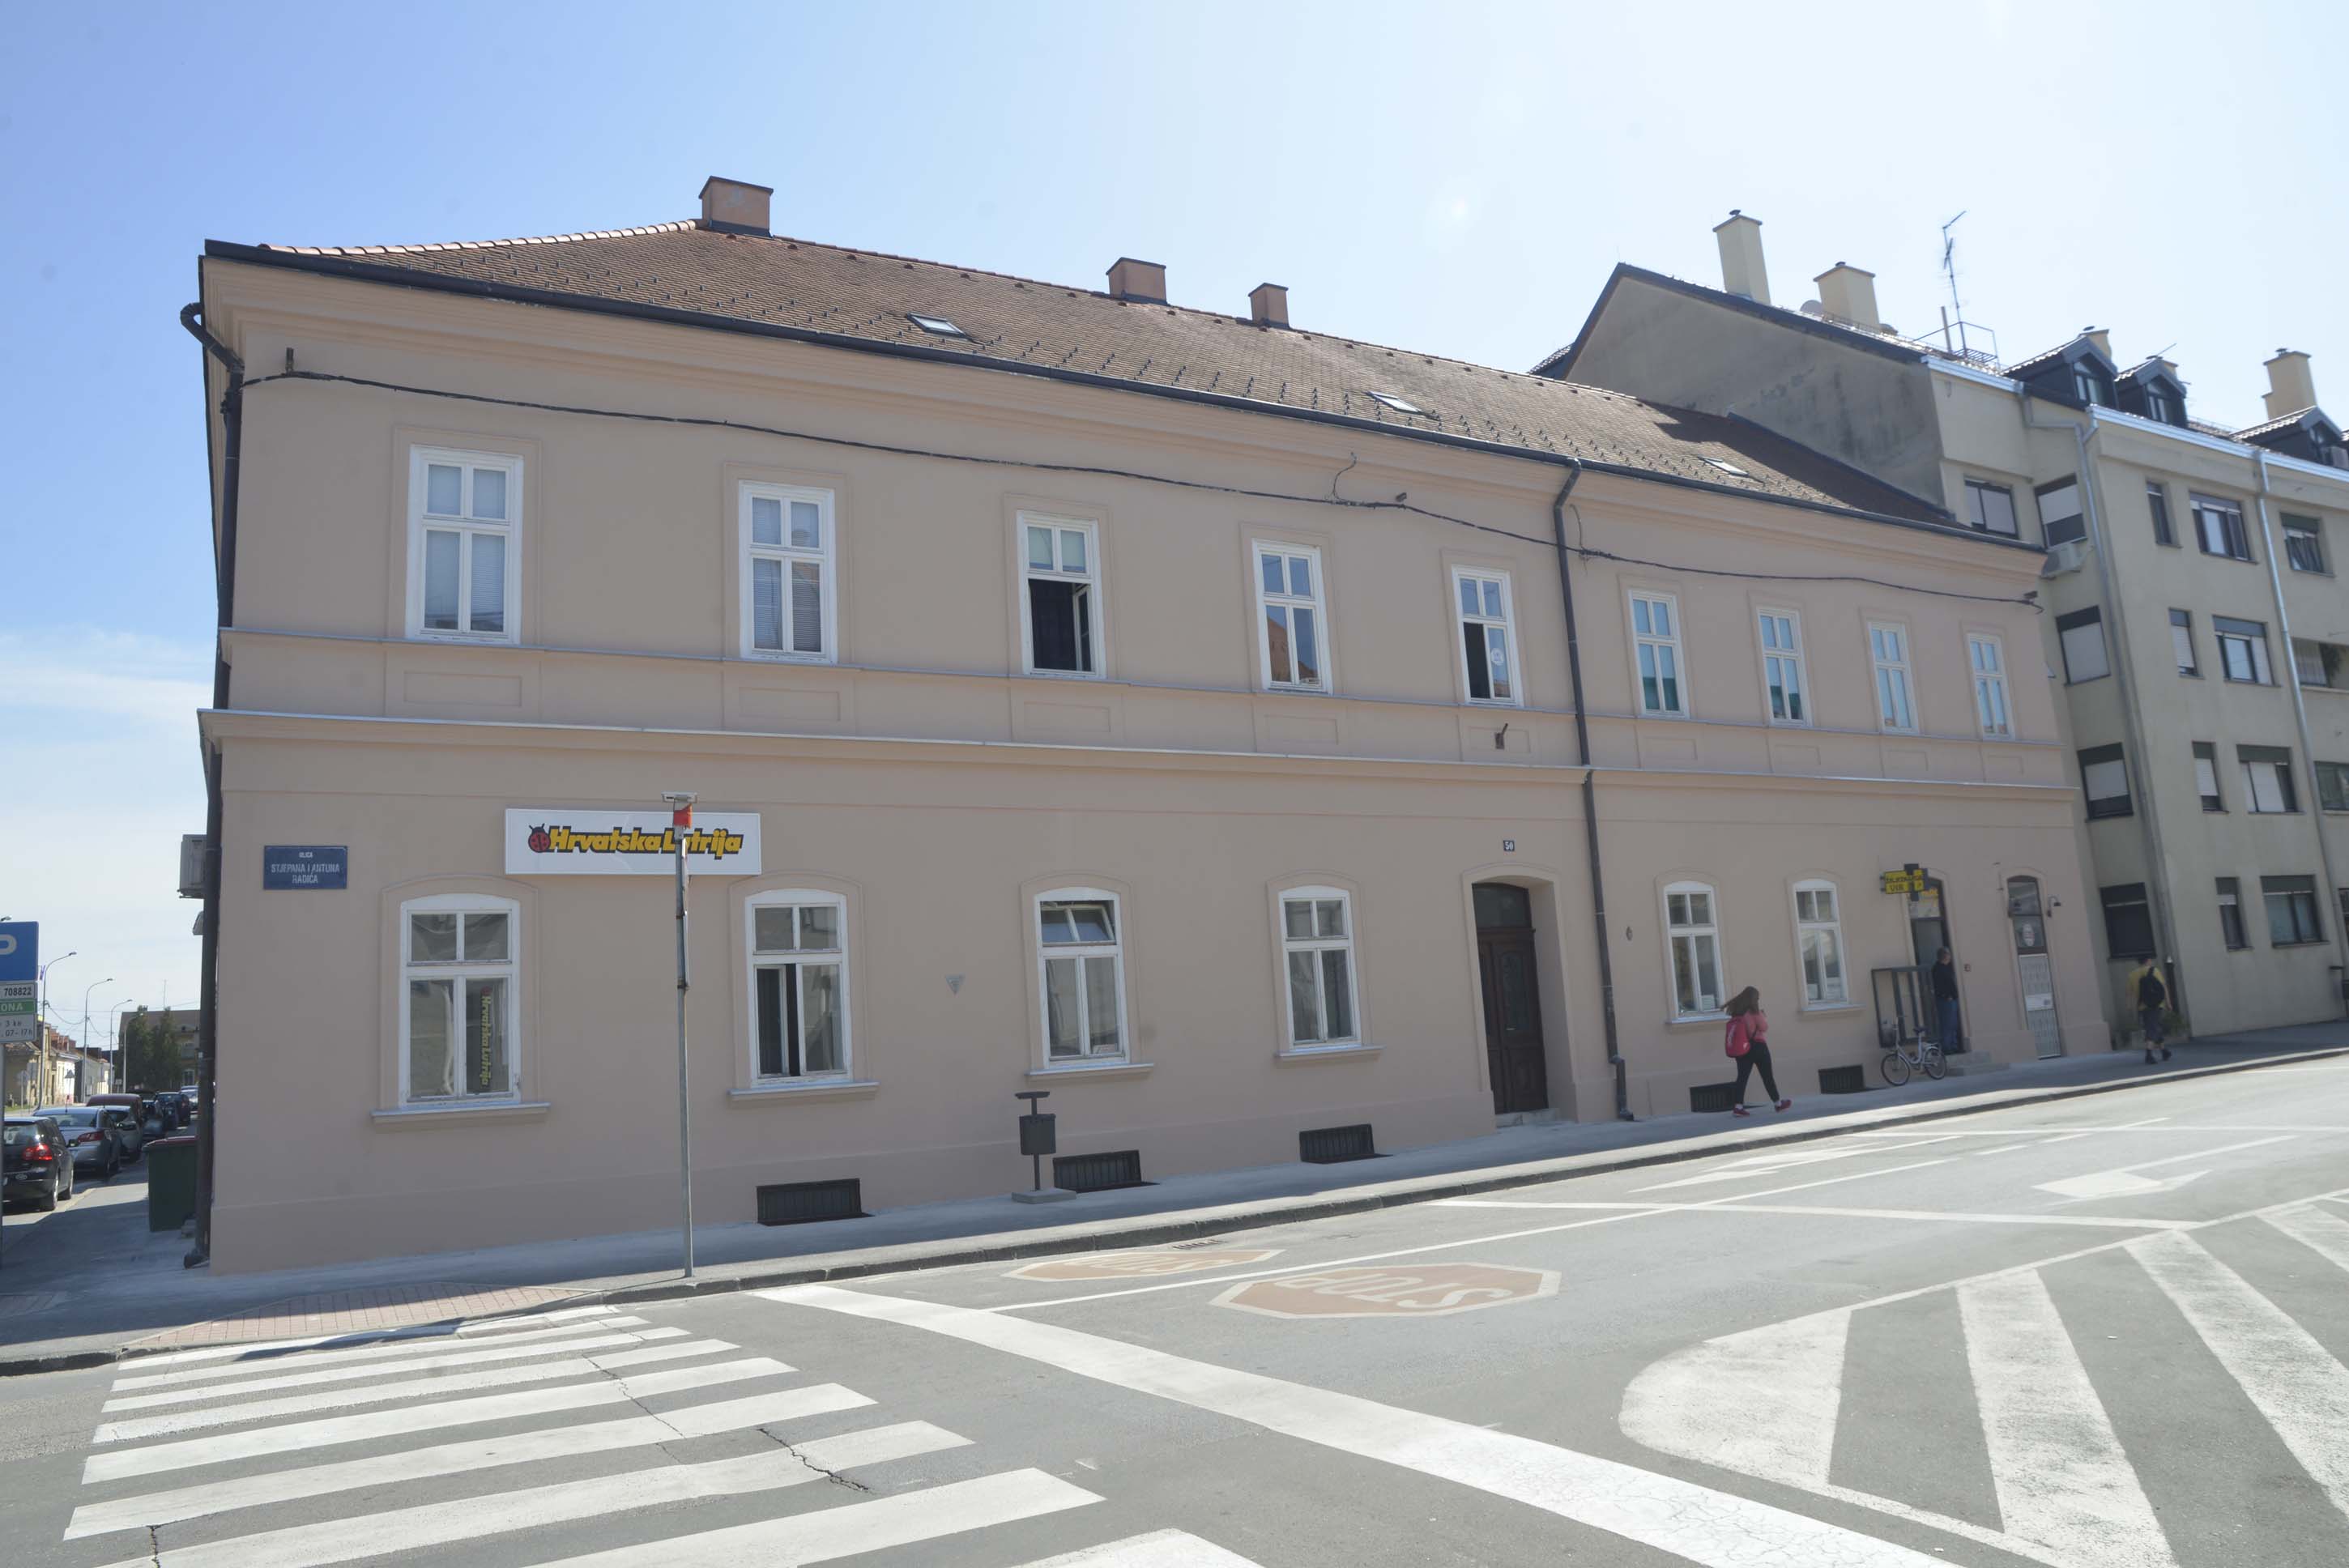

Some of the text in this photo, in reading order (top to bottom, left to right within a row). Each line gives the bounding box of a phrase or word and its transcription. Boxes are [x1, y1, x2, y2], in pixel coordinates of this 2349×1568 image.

[549, 825, 661, 854] Hrvatska
[1505, 842, 1514, 850] 50
[271, 863, 305, 873] STJEPANA
[311, 863, 340, 873] ANTUNA
[292, 872, 318, 884] RADIĆA
[4, 987, 32, 996] 708822
[0, 1003, 23, 1012] ONA
[1274, 1272, 1514, 1310] STOP
